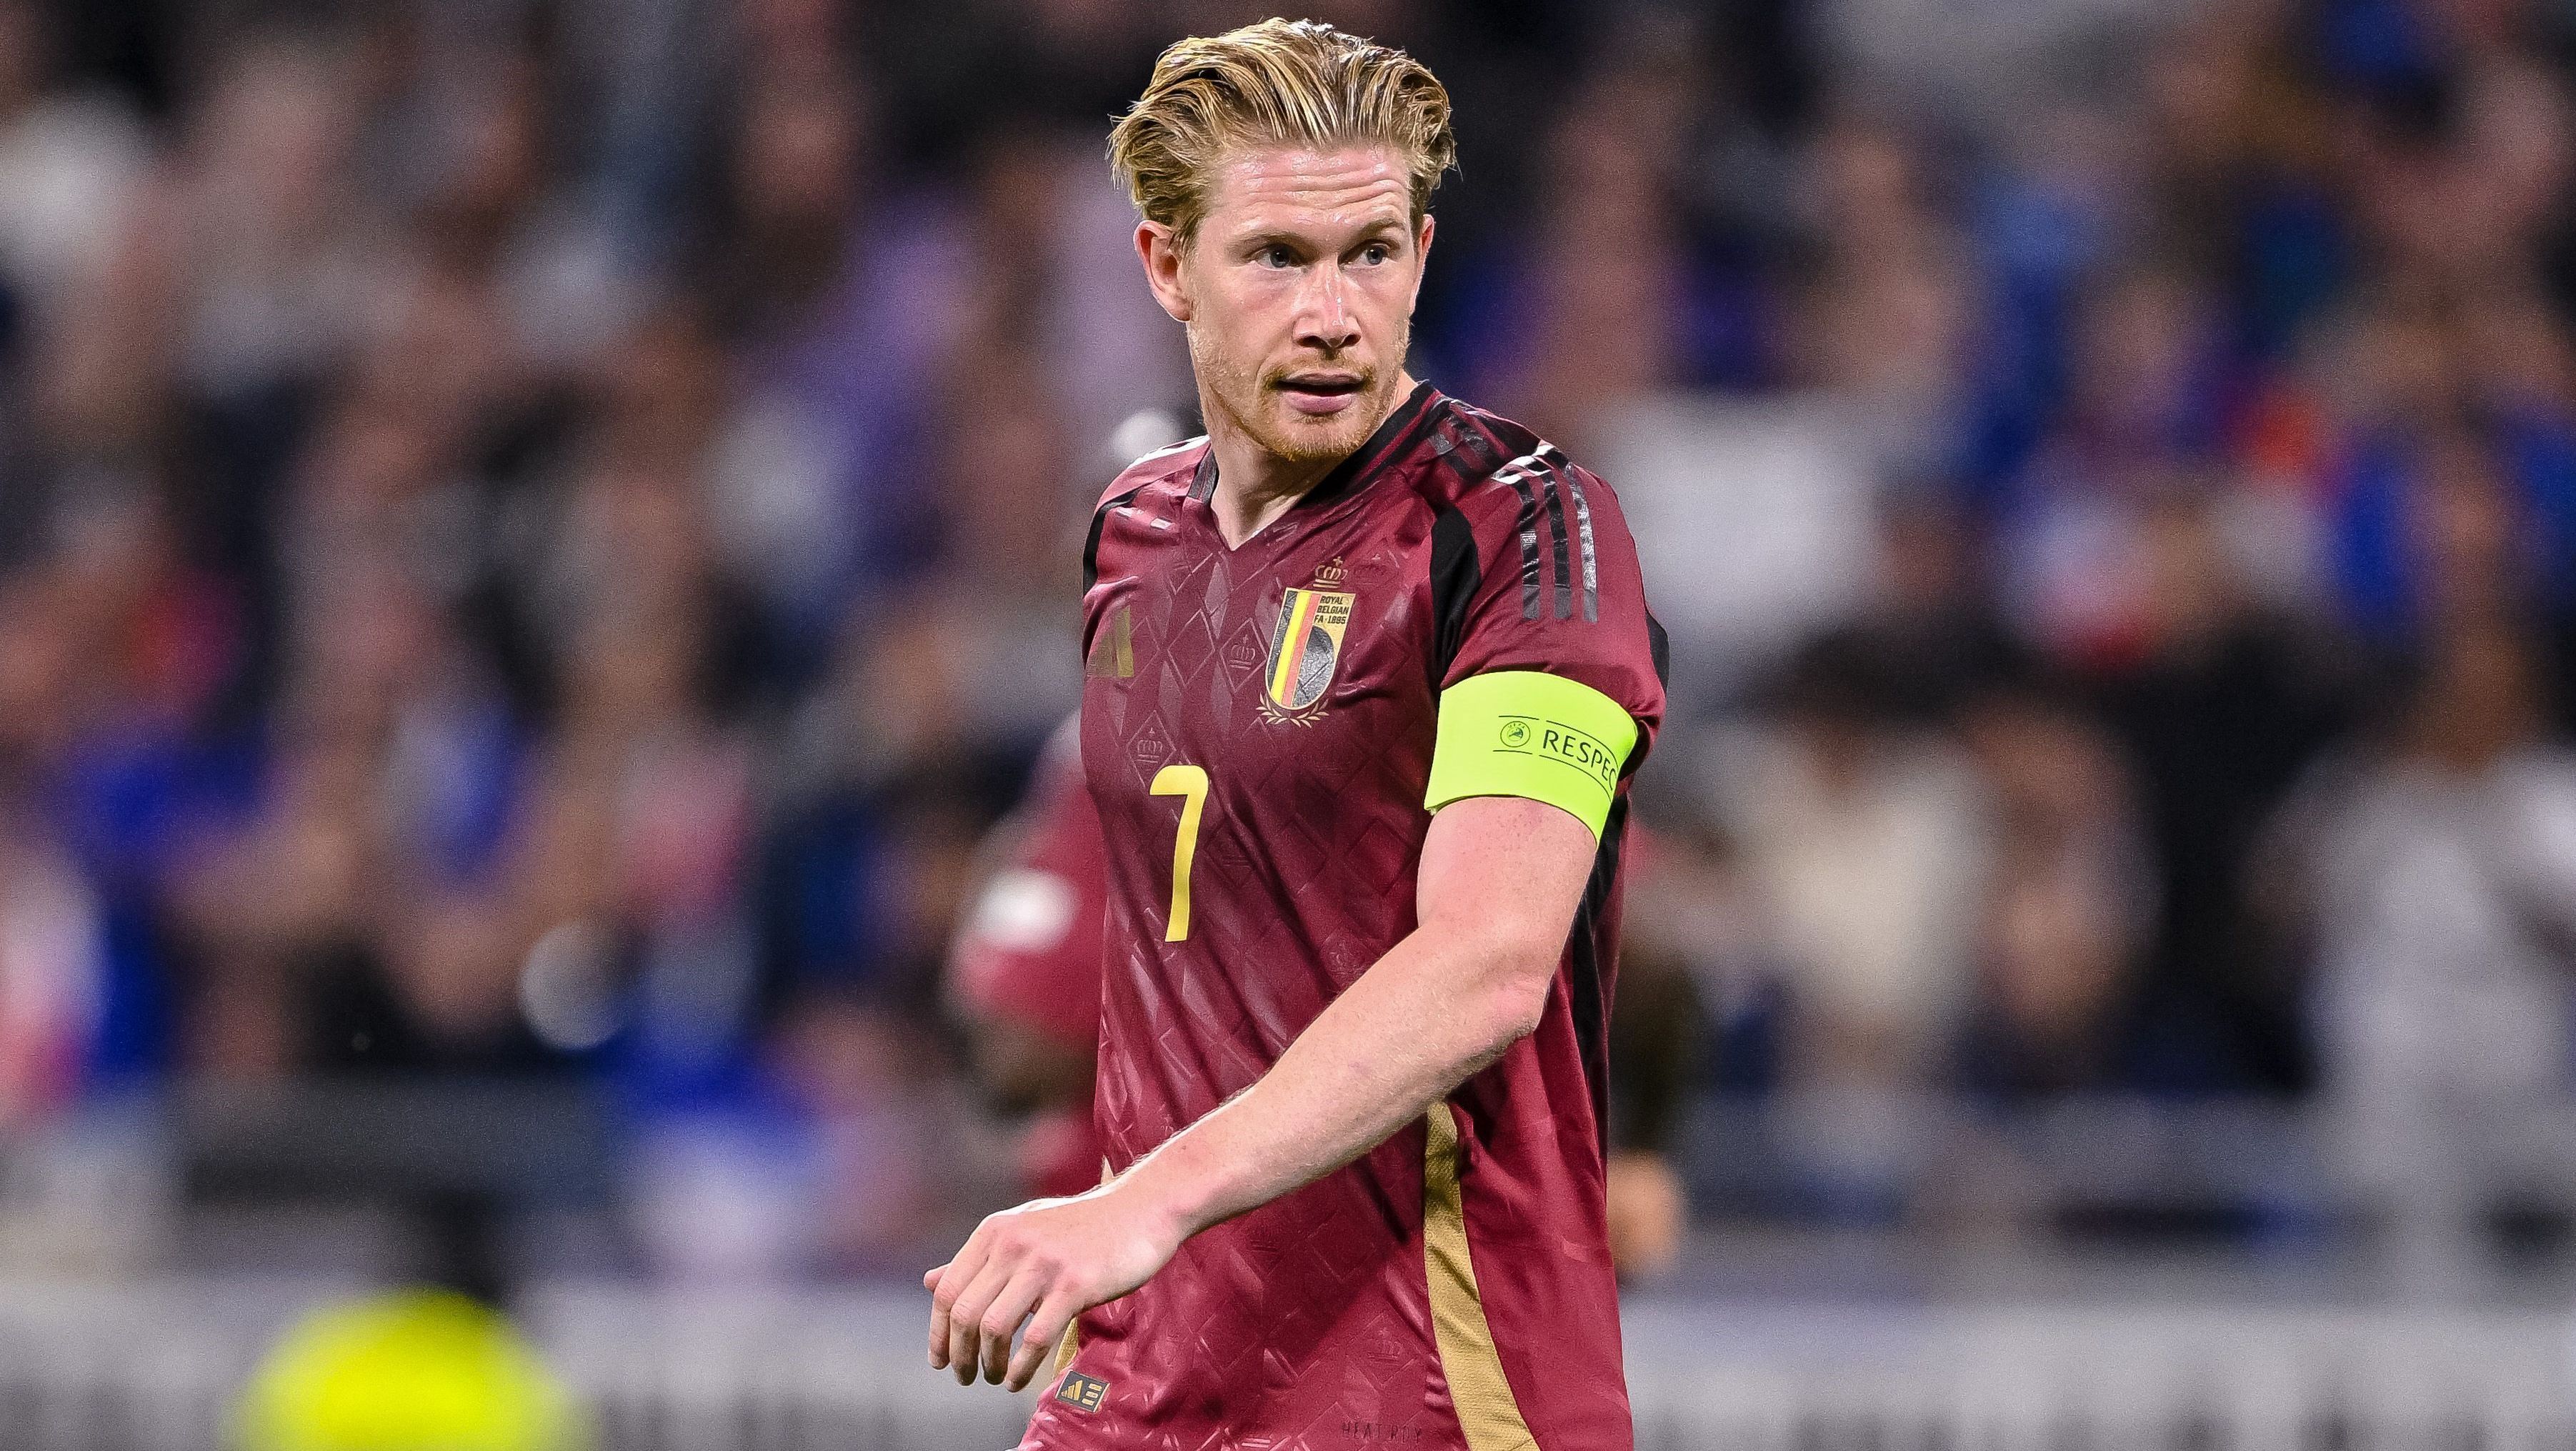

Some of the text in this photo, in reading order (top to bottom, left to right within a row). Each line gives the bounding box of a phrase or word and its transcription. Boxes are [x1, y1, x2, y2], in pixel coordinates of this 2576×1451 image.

[1319, 595, 1344, 604] ROYAL
[1317, 605, 1349, 614] BELGIAN
[1149, 764, 1209, 942] 7
